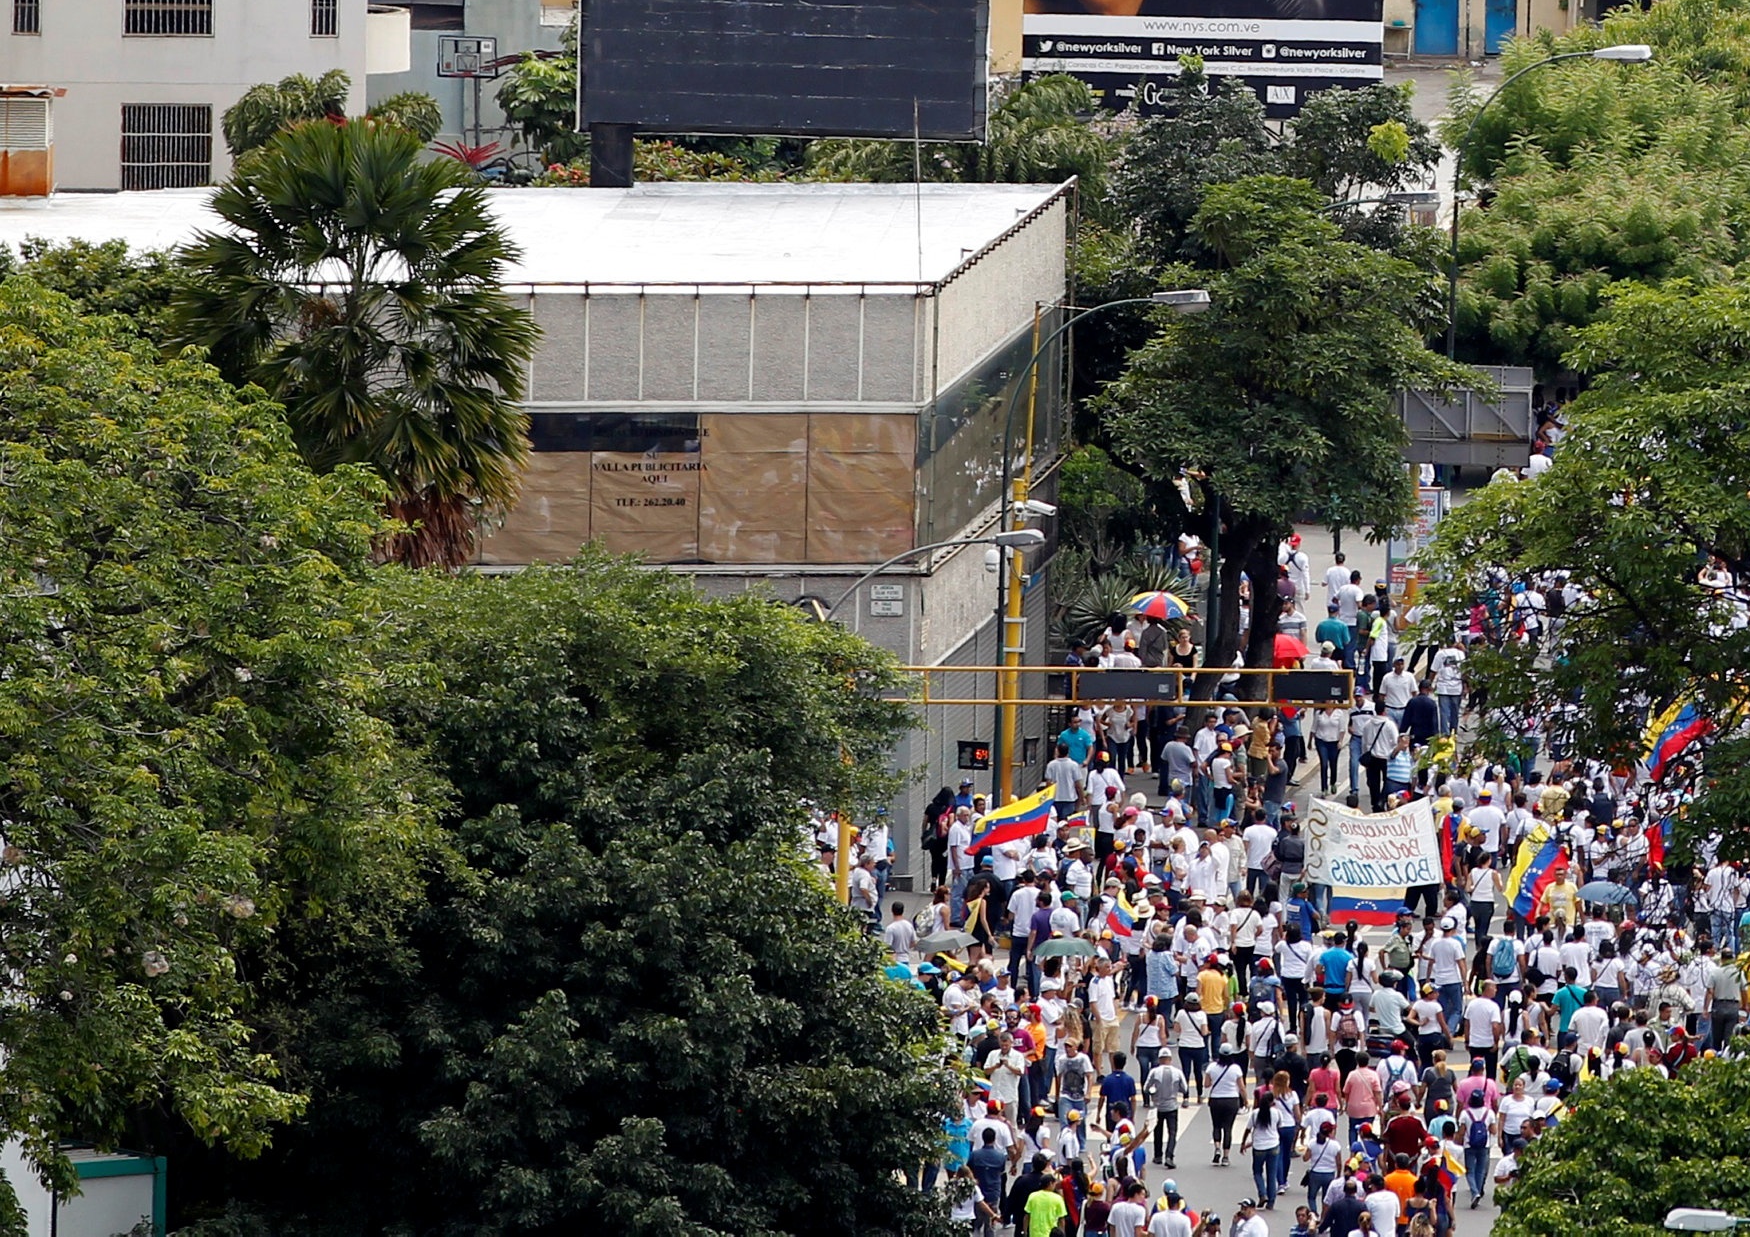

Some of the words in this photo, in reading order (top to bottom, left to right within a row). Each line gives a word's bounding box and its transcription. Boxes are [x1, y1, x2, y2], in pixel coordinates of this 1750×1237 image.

[1143, 20, 1260, 34] www.nys.com.ve
[1056, 40, 1142, 54] @newyorksilver
[1222, 45, 1253, 56] Silver
[1279, 45, 1366, 59] @newyorksilver
[594, 463, 628, 472] VALLA
[631, 462, 708, 472] PUBLICITARIA
[641, 475, 668, 484] AQUI
